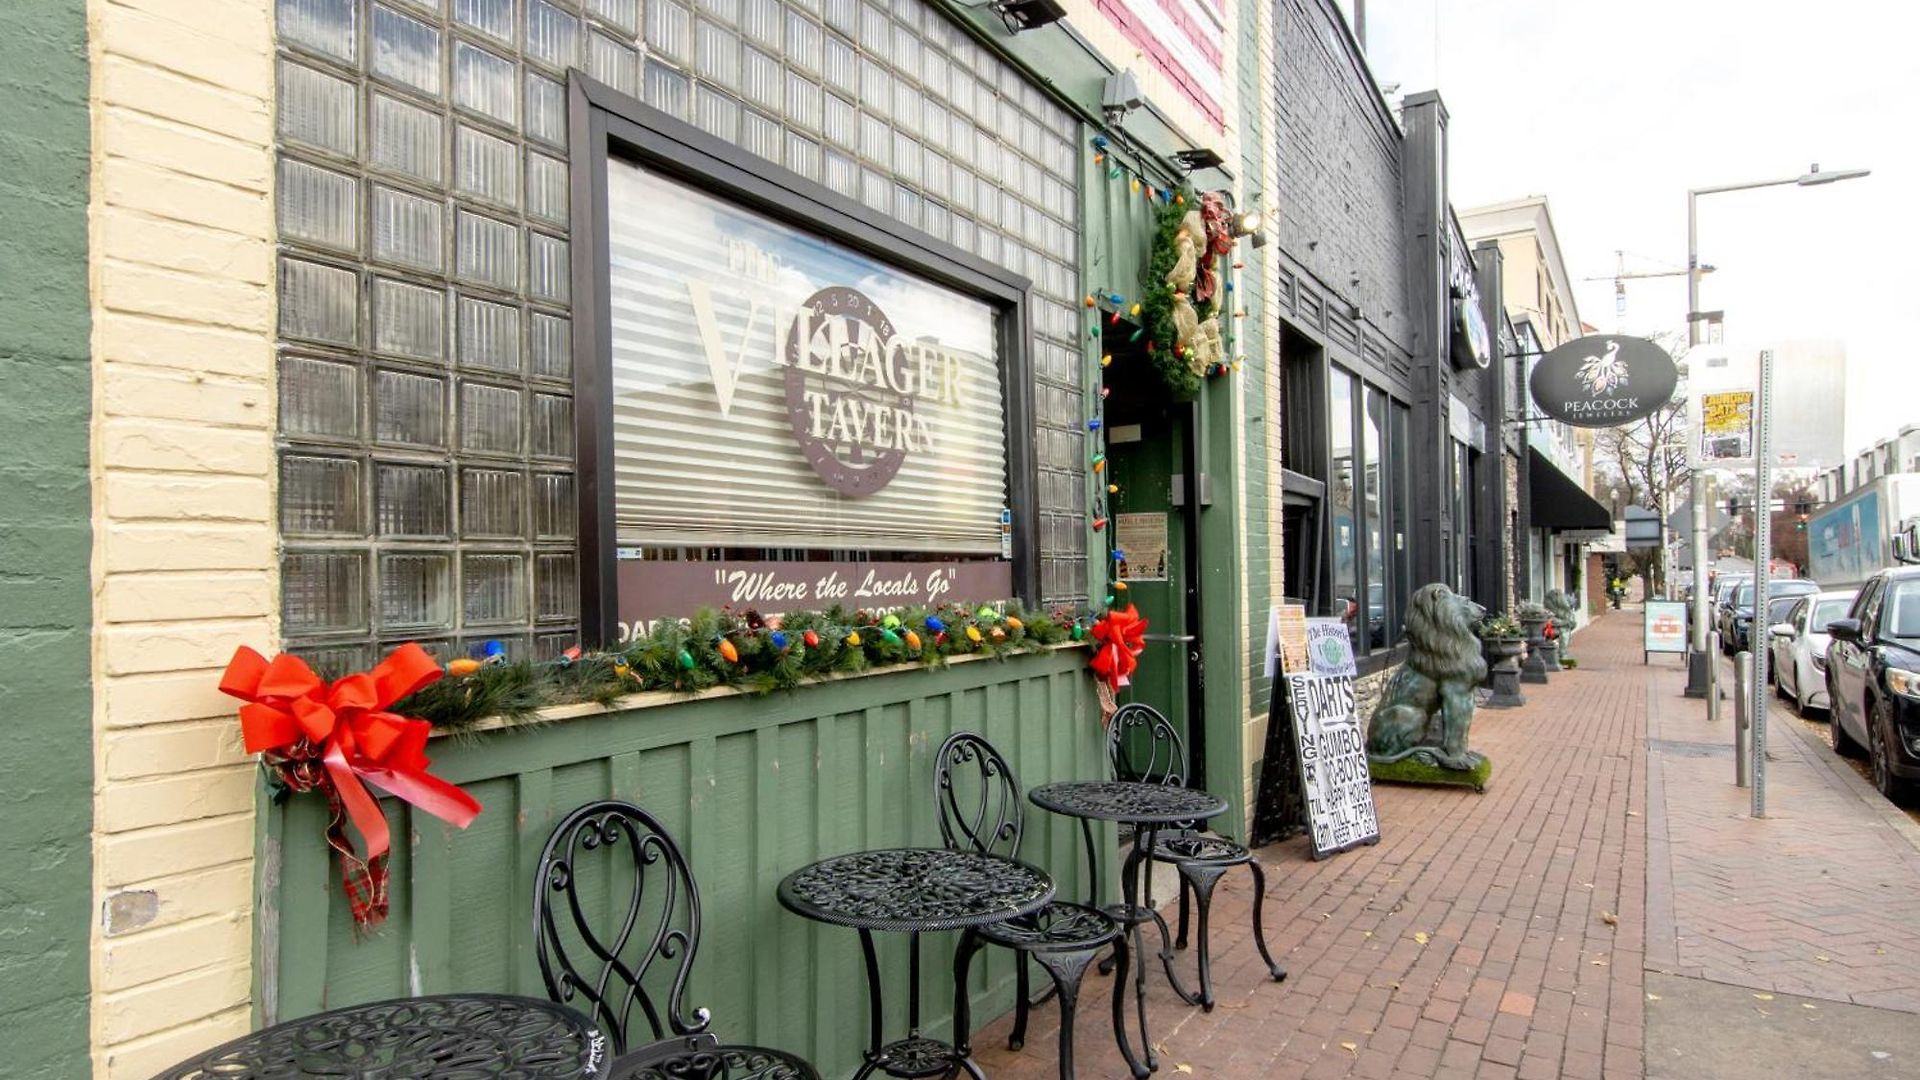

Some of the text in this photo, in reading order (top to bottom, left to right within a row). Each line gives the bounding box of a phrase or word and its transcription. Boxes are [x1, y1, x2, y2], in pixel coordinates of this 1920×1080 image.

[847, 293, 860, 308] 20
[682, 275, 962, 418] VILLAGER
[1564, 397, 1638, 412] PEACOCK
[803, 391, 937, 454] TAVERN
[715, 568, 956, 602] "Where the Locals Go"
[1308, 675, 1355, 719] DARTS
[1292, 676, 1318, 760] SERVING
[1320, 728, 1362, 760] GUMBO
[1329, 809, 1350, 828] TILL
